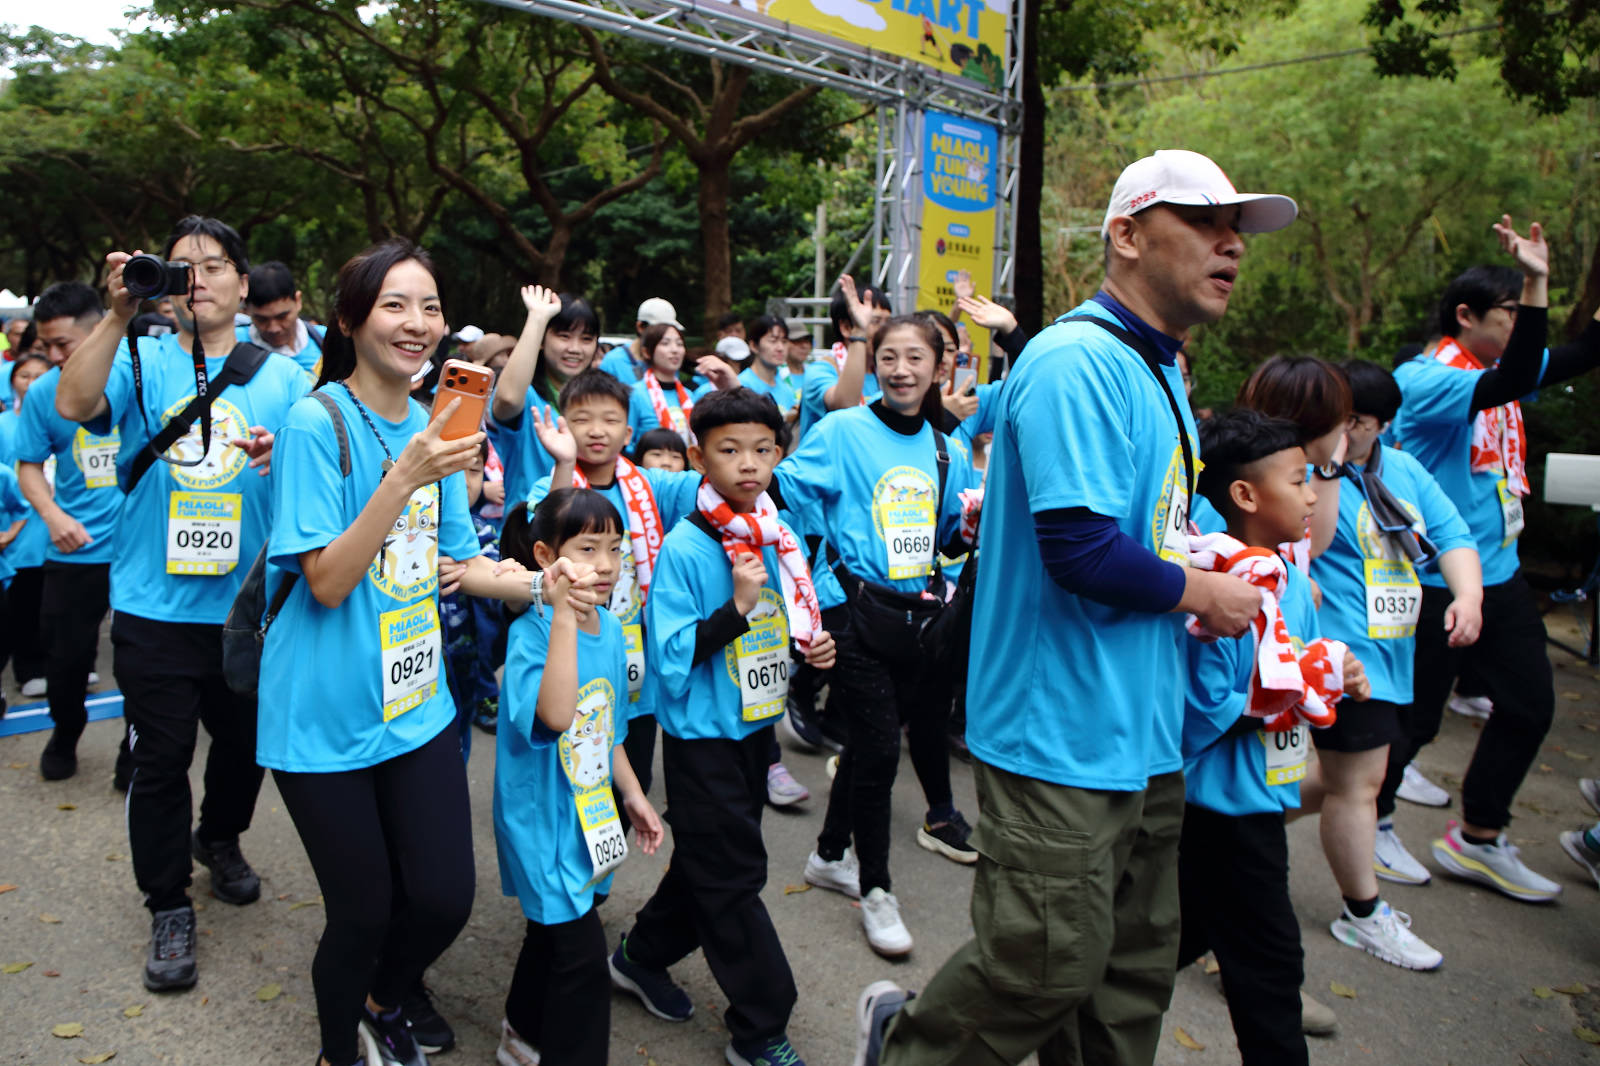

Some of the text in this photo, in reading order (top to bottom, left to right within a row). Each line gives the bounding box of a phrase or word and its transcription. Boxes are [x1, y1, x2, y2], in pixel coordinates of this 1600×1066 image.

[866, 0, 986, 40] ART
[931, 132, 989, 164] MIAOLI
[935, 154, 968, 178] FUN
[931, 172, 988, 202] YOUNG
[177, 500, 224, 510] MIAOLI
[176, 529, 233, 549] 0920
[893, 535, 930, 554] 0669
[1374, 596, 1417, 613] 0337
[389, 610, 427, 634] MIAOLI
[389, 620, 434, 645] FUN YOUNG
[741, 627, 776, 645] MIAOLI
[391, 646, 433, 685] 0921
[747, 660, 787, 689] 0670
[584, 800, 610, 817] MIAOLI
[595, 834, 625, 866] 0923
